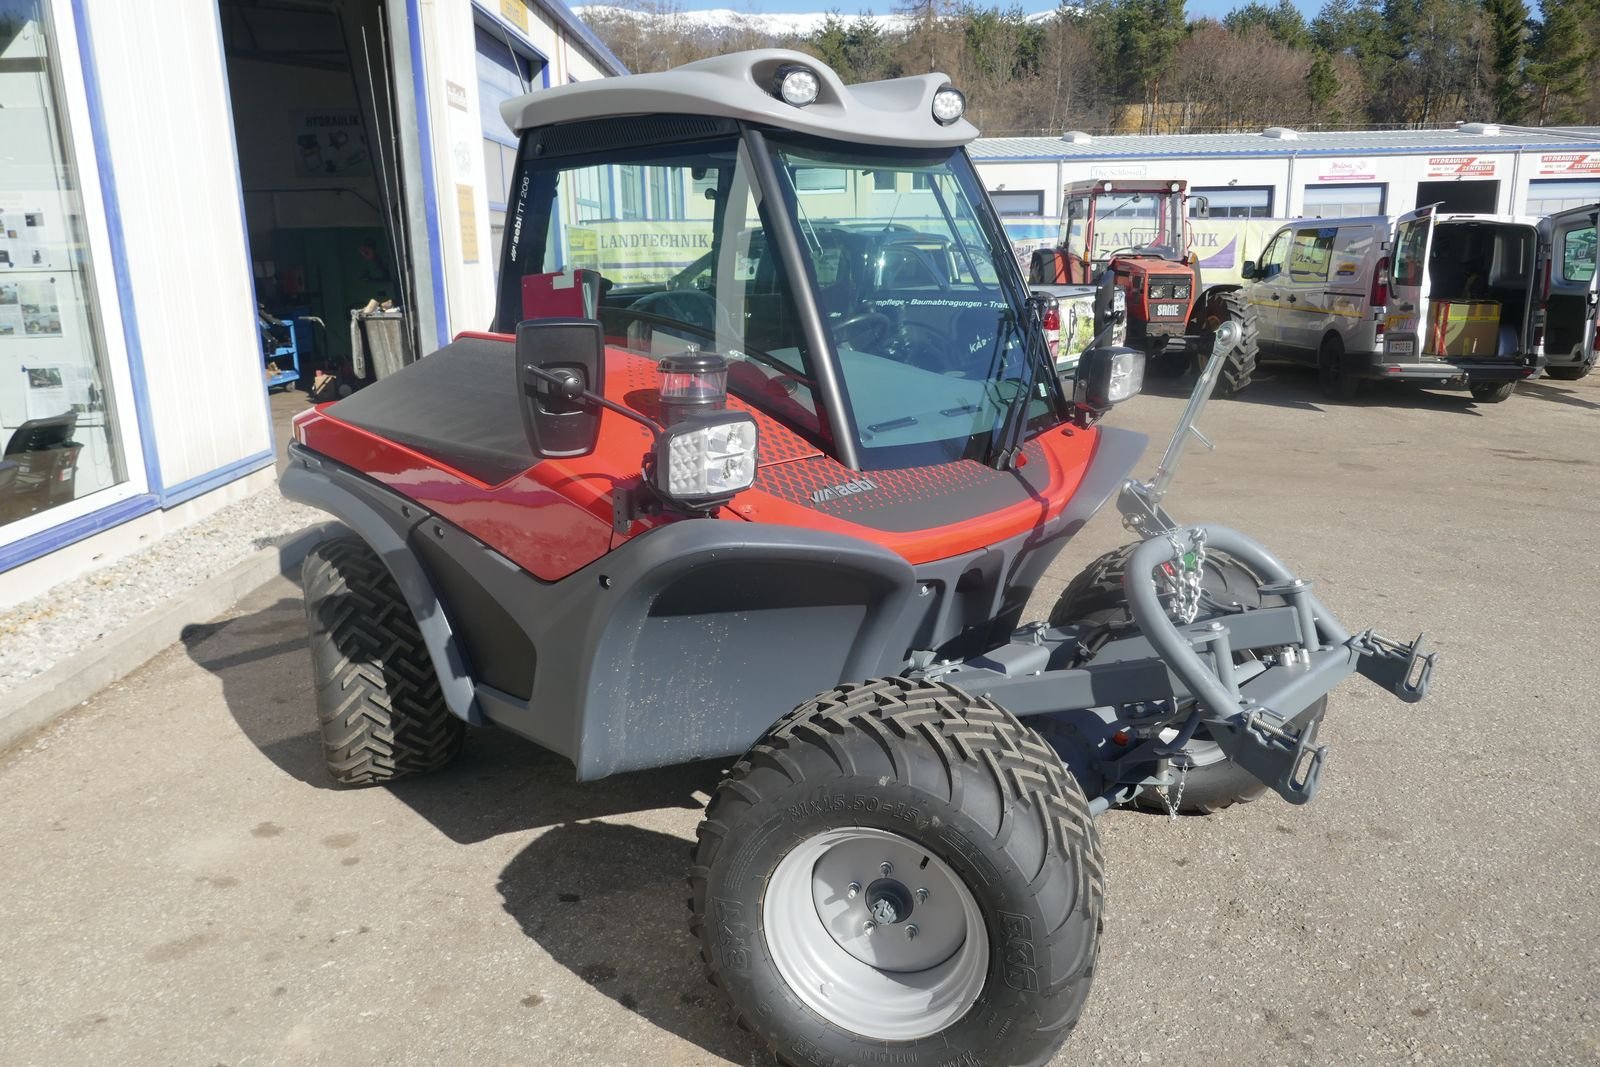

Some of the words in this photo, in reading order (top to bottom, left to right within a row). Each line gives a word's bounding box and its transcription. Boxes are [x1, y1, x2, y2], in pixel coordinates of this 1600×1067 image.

[600, 233, 709, 249] LANDTECHNIK
[911, 298, 983, 309] Baumabtragungen
[1157, 304, 1179, 316] SAME
[835, 477, 878, 496] aebi
